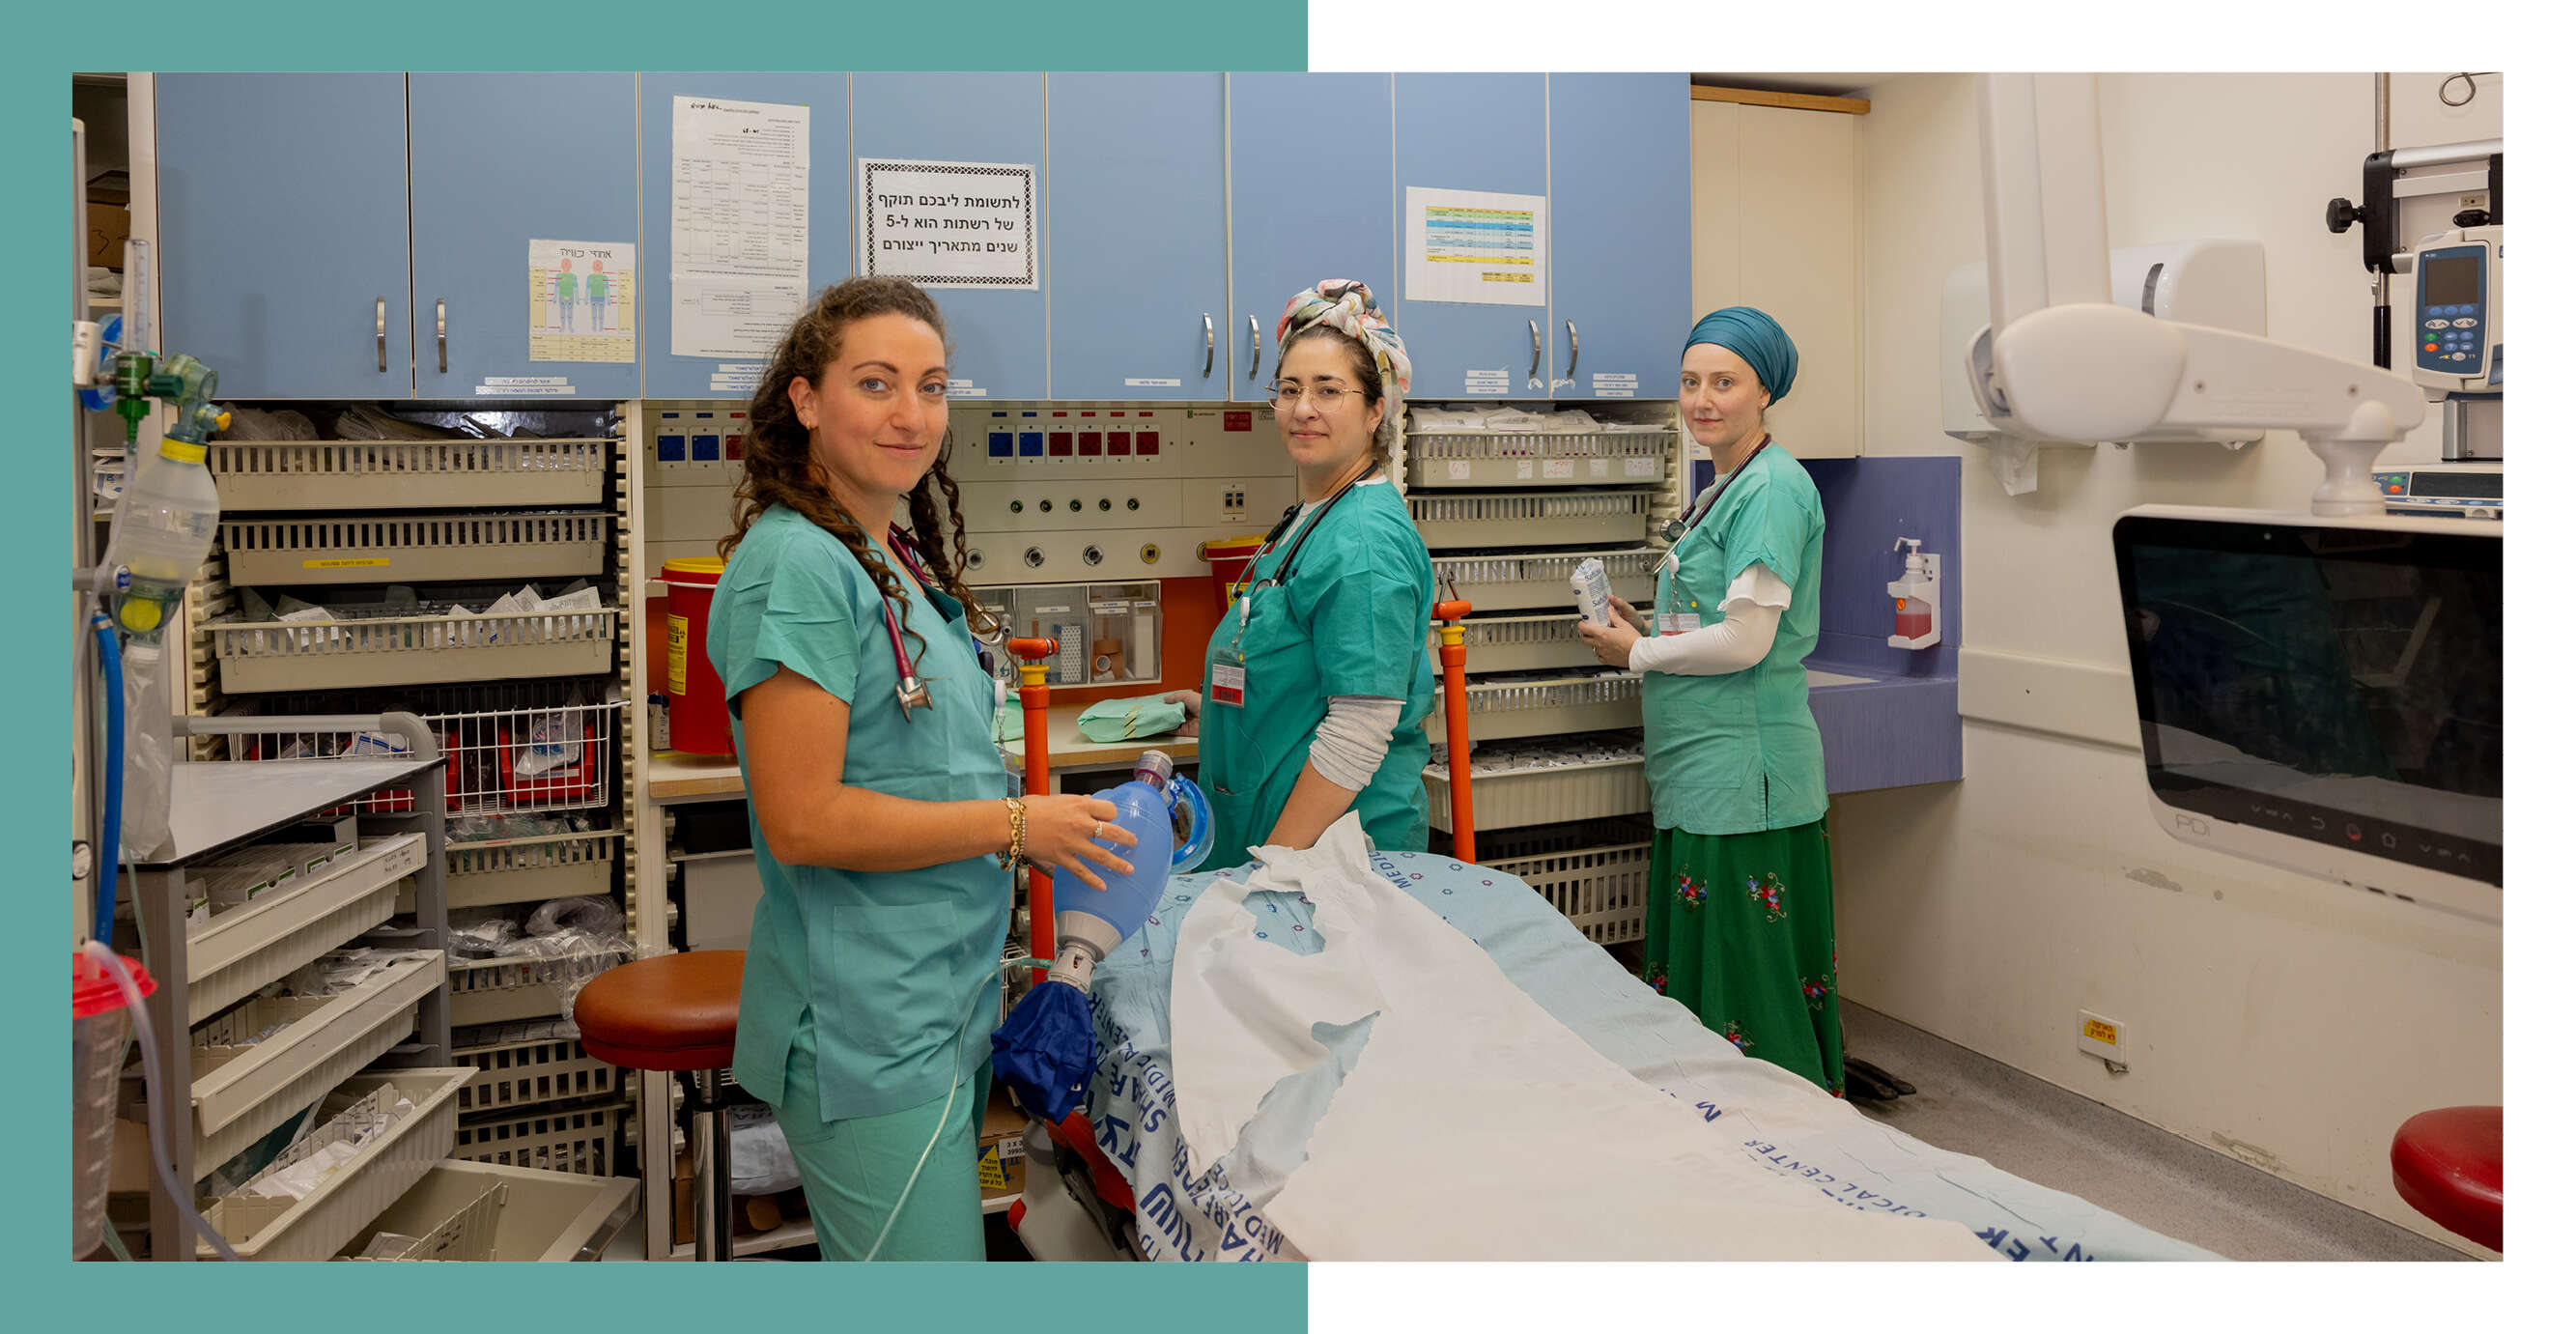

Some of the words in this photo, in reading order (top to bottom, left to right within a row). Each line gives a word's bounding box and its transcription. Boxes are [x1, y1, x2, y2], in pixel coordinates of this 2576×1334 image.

[878, 193, 914, 209] תוקף
[919, 193, 959, 207] ליבכם
[964, 195, 1021, 209] לתשומת
[886, 213, 909, 228] ל-5
[914, 217, 938, 229] הוא
[943, 218, 990, 230] רשתות
[994, 216, 1014, 231] של
[882, 239, 923, 251] ייצורם
[928, 240, 981, 254] מתאריך
[986, 241, 1018, 253] שנים
